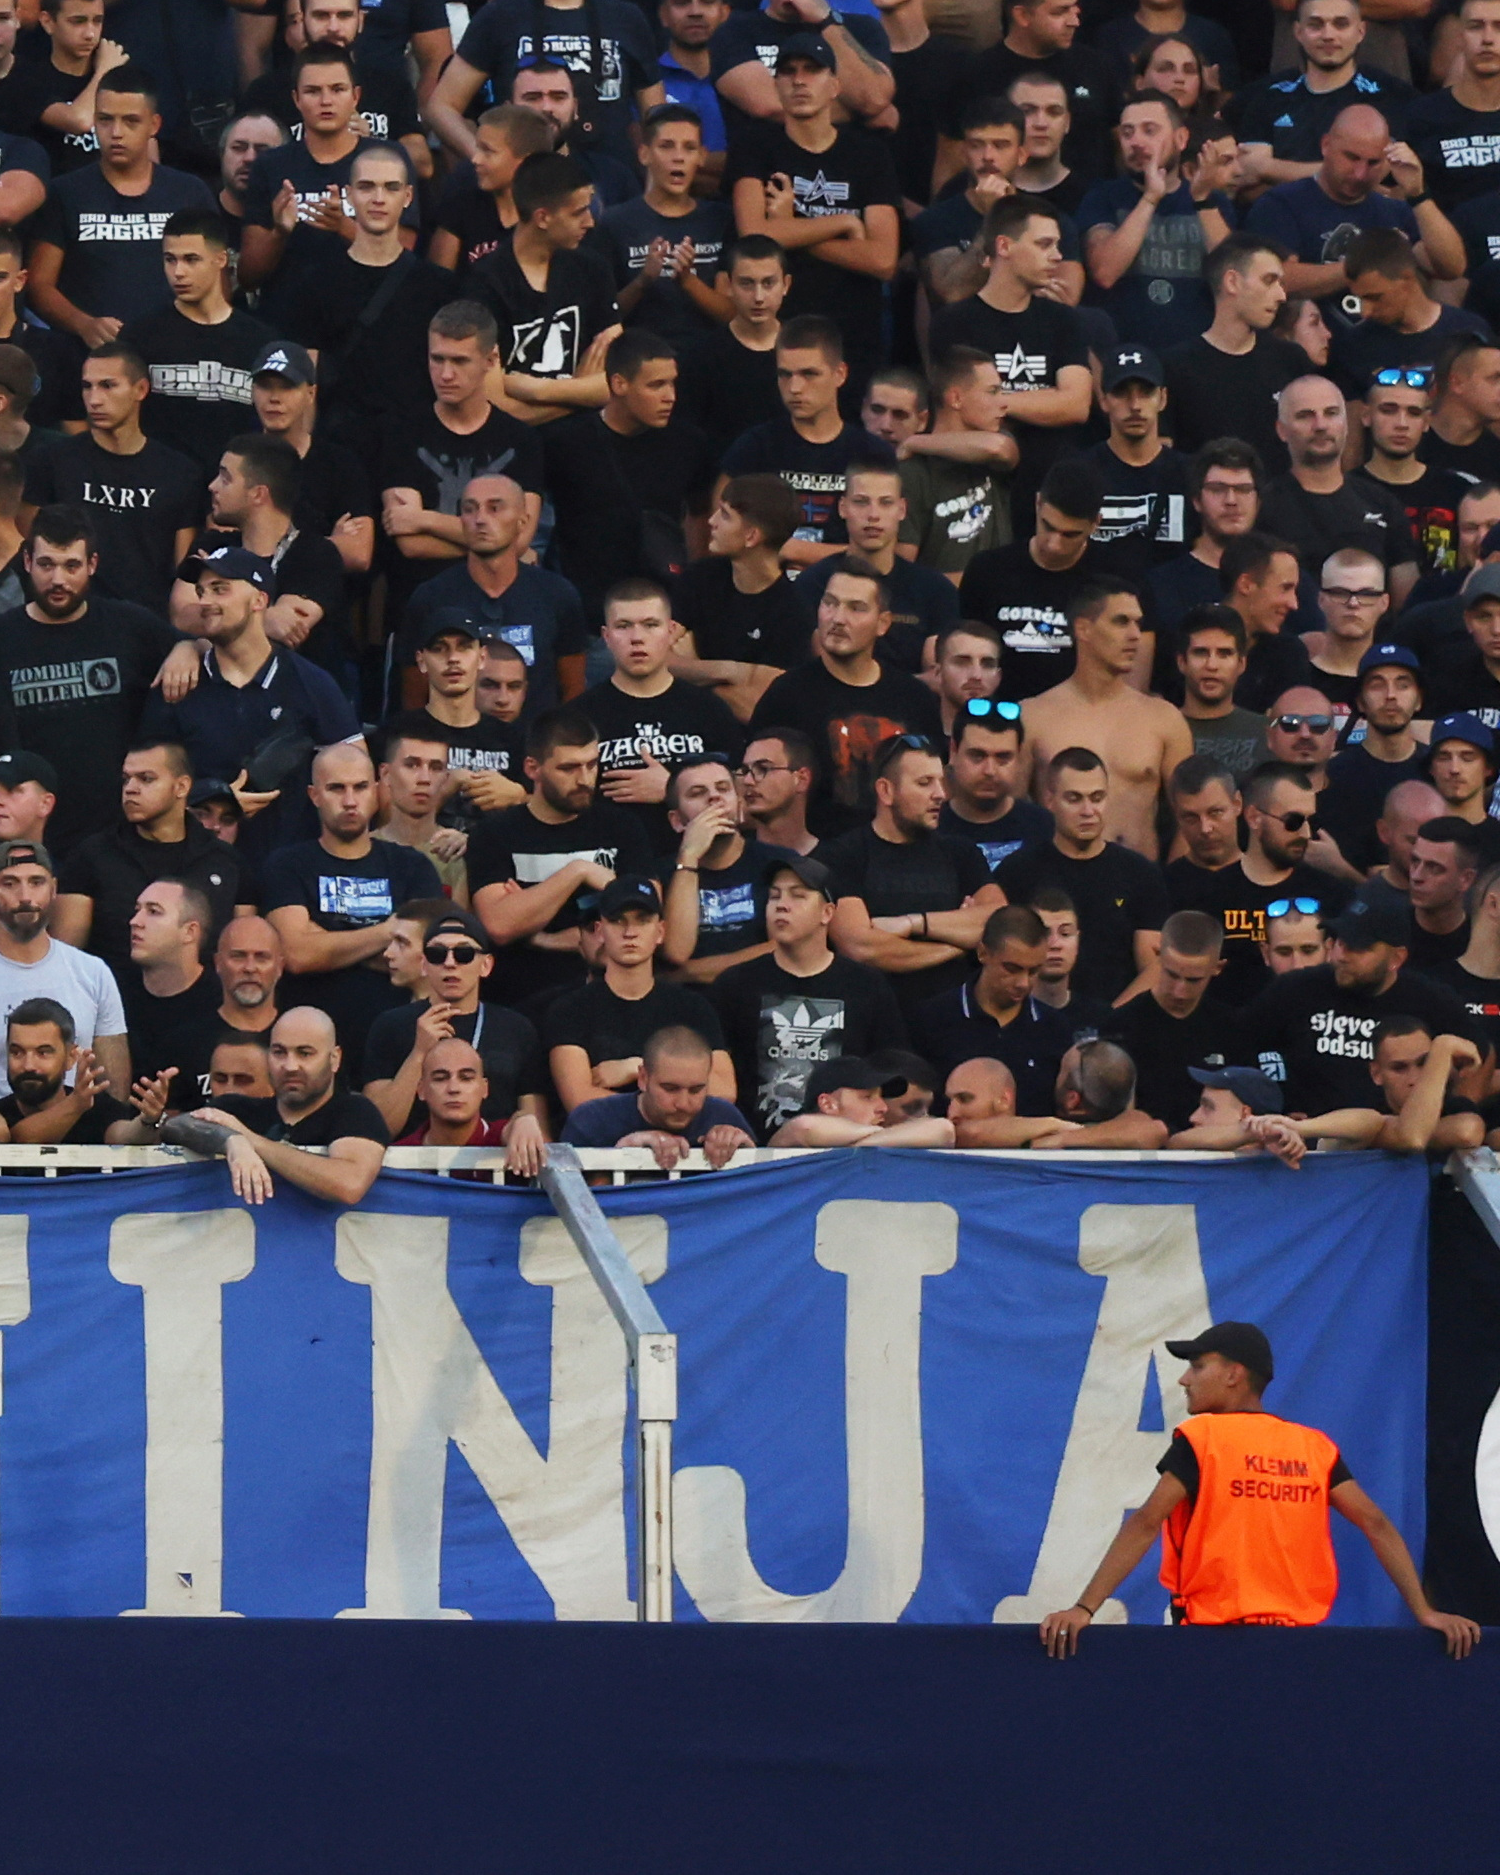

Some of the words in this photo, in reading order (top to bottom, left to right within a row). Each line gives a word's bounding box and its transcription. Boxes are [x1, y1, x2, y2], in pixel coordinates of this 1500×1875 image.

[79, 212, 107, 224] BAD
[110, 212, 144, 224] BLUE
[147, 211, 175, 224] BOY
[78, 223, 165, 242] ZAGRE
[83, 482, 158, 509] LXRY
[9, 661, 83, 685] ZOMBIE
[13, 685, 86, 708] KILLER
[448, 747, 474, 766] LUE
[474, 749, 510, 770] BOYS
[598, 730, 704, 765] ZAGREB
[767, 1045, 828, 1062] adidas
[1316, 1035, 1375, 1061] odsu
[1245, 1454, 1309, 1476] KLEMM
[1230, 1480, 1321, 1503] SECURITY
